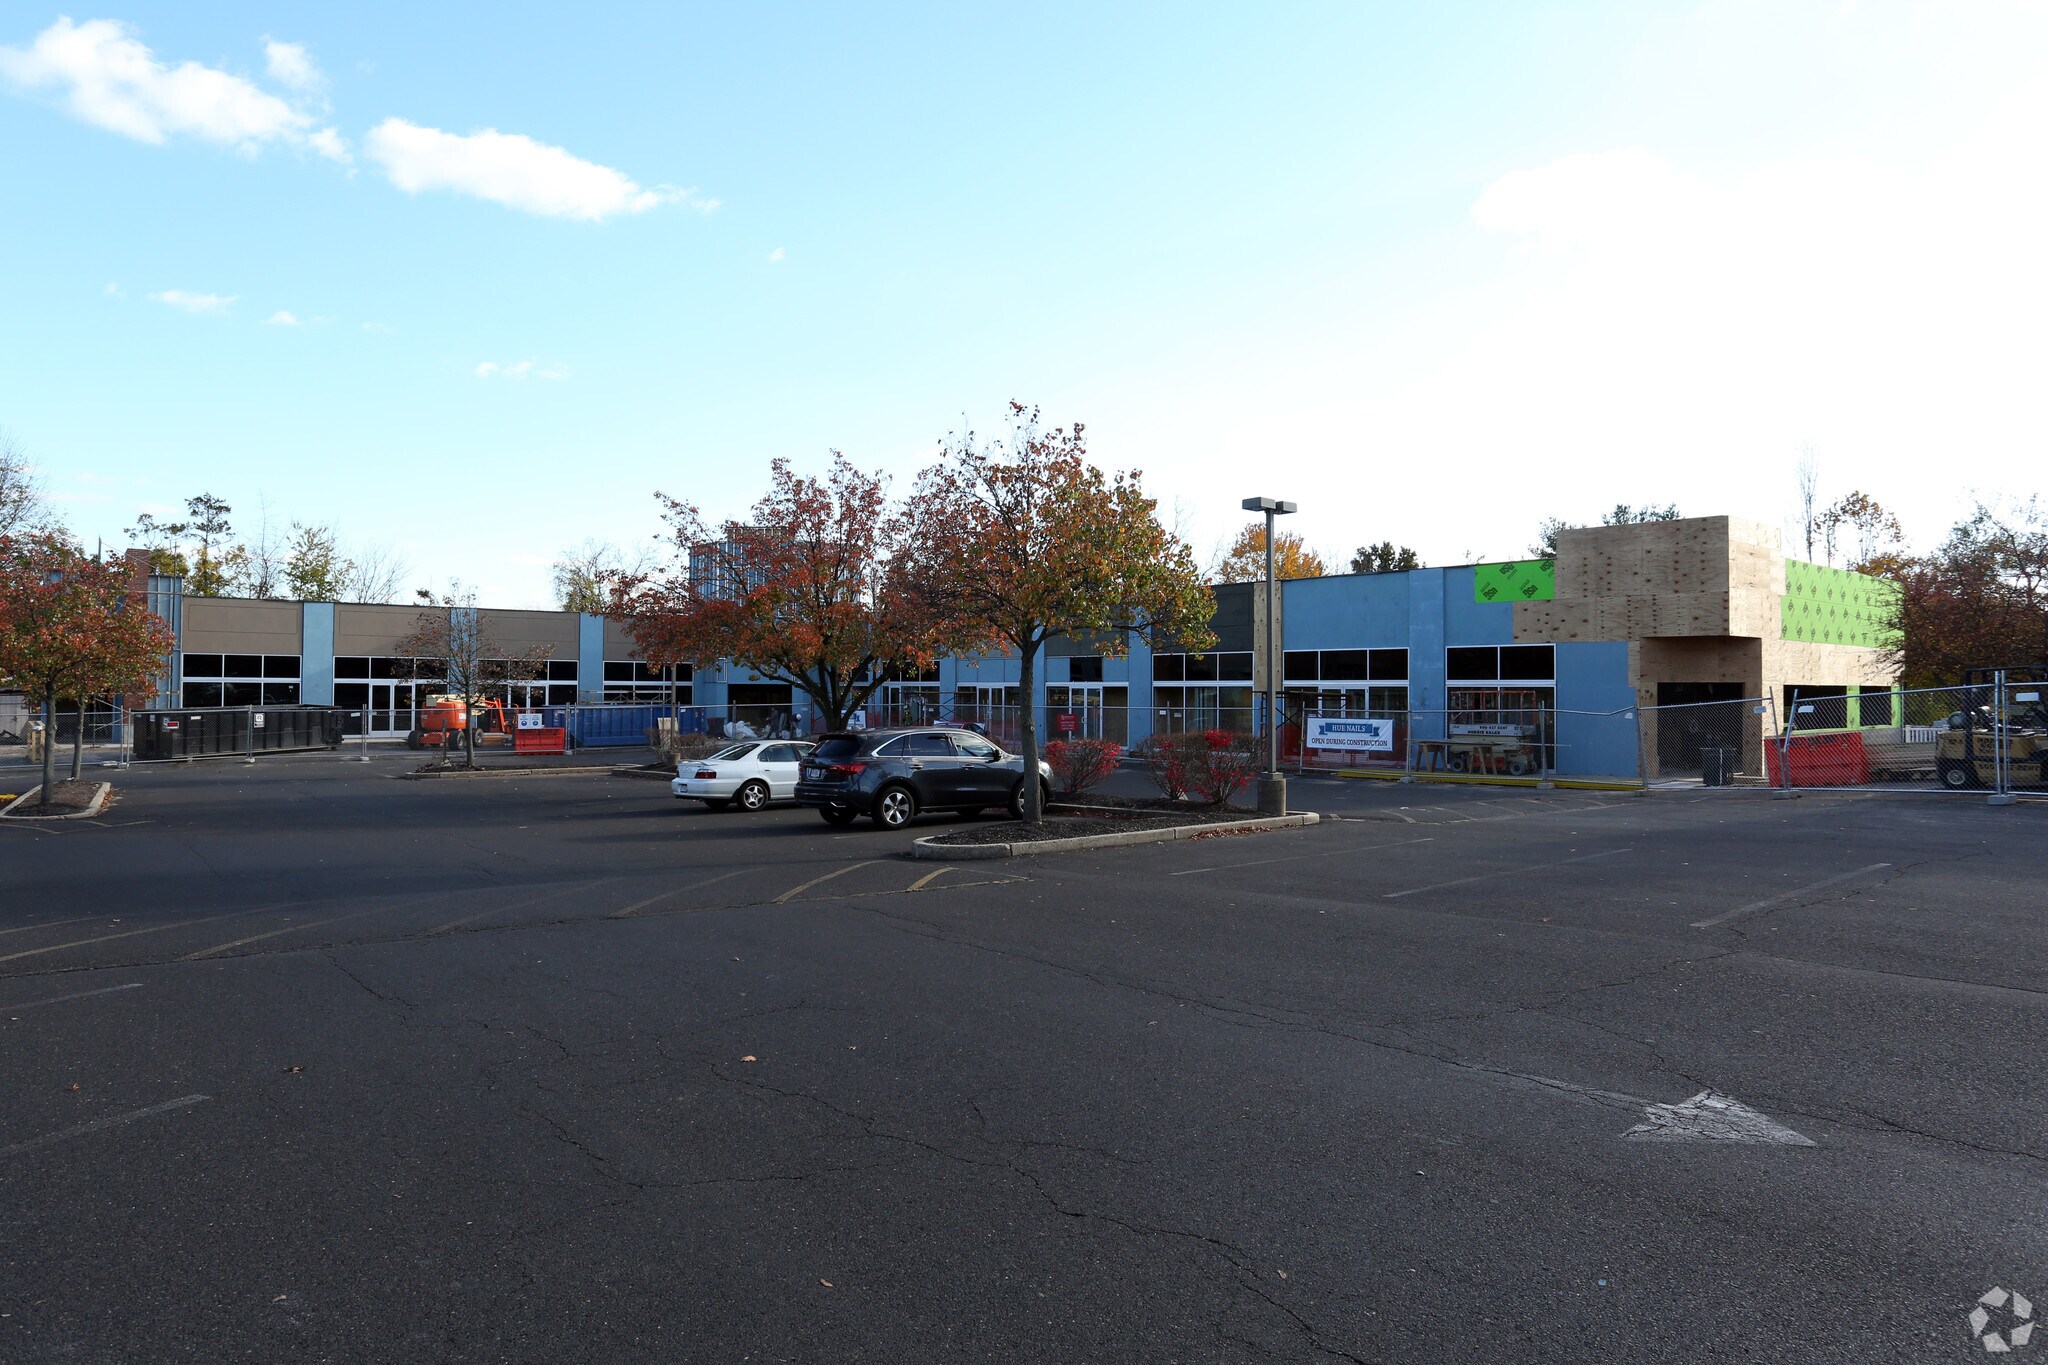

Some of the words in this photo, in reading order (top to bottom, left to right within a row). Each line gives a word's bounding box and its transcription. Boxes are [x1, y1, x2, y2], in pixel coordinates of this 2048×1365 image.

[1483, 587, 1498, 600] USG
[1522, 584, 1539, 598] USG
[1332, 724, 1346, 732] HUE
[1325, 738, 1346, 746] DURING
[1346, 739, 1388, 747] CONSTRUCTION
